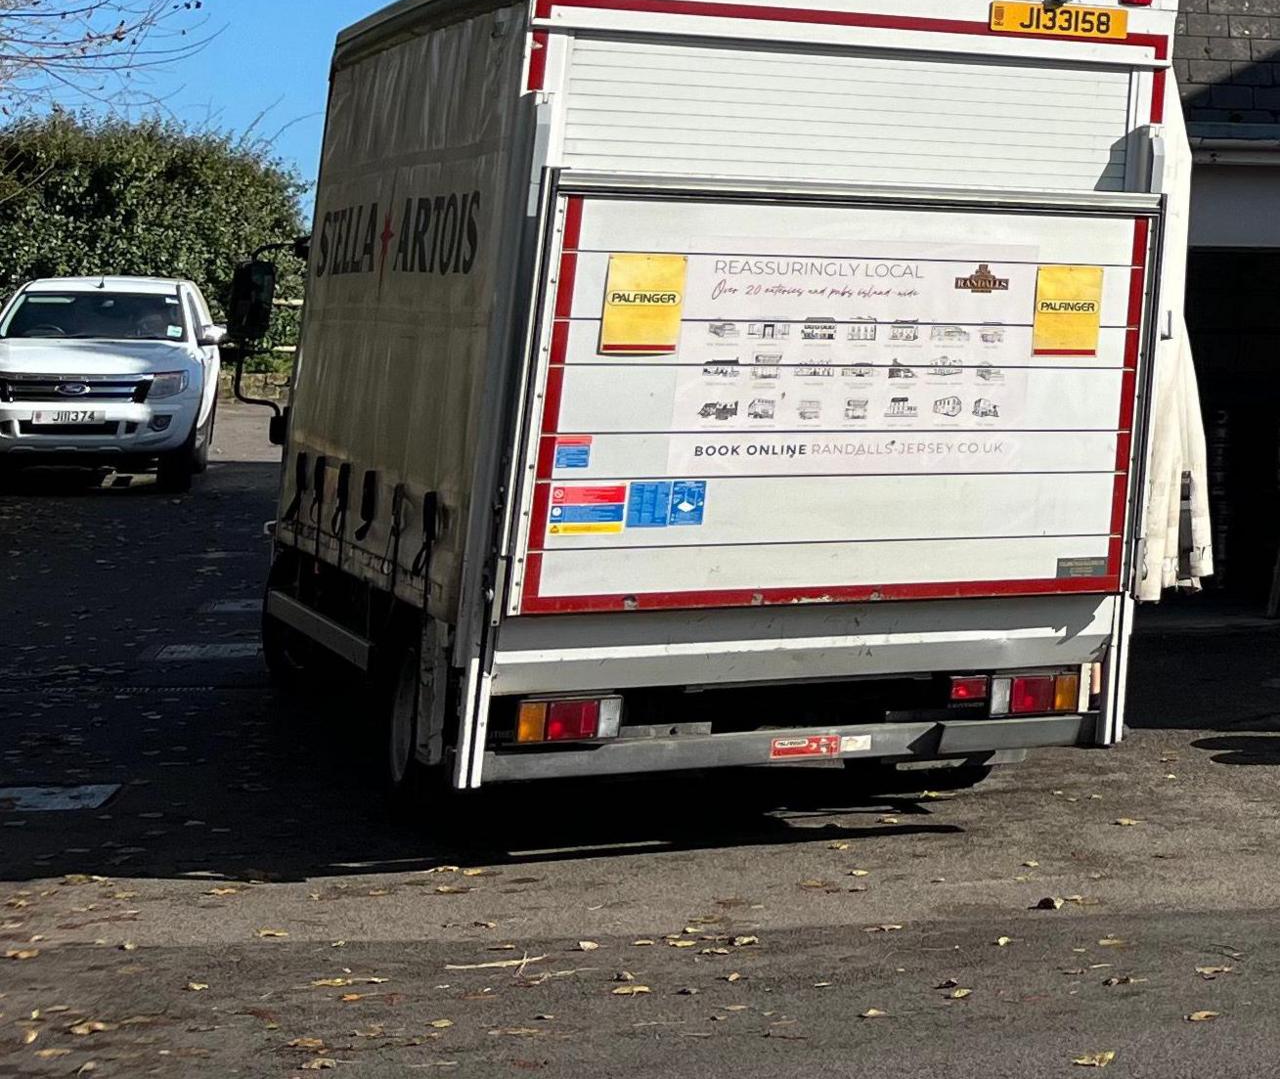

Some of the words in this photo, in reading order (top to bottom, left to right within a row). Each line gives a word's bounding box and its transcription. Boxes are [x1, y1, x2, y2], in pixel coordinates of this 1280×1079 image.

[1020, 7, 1111, 34] J133158
[316, 202, 379, 278] STELLA
[392, 190, 481, 277] ARTOIS
[714, 260, 860, 277] REASSURINGLY
[865, 263, 925, 279] LOCAL
[611, 292, 676, 304] PALFINGER
[712, 279, 738, 300] Over
[745, 284, 762, 295] 20
[1040, 301, 1095, 312] PALFINGER
[694, 444, 740, 456] BOOK
[746, 443, 807, 457] ONLINE
